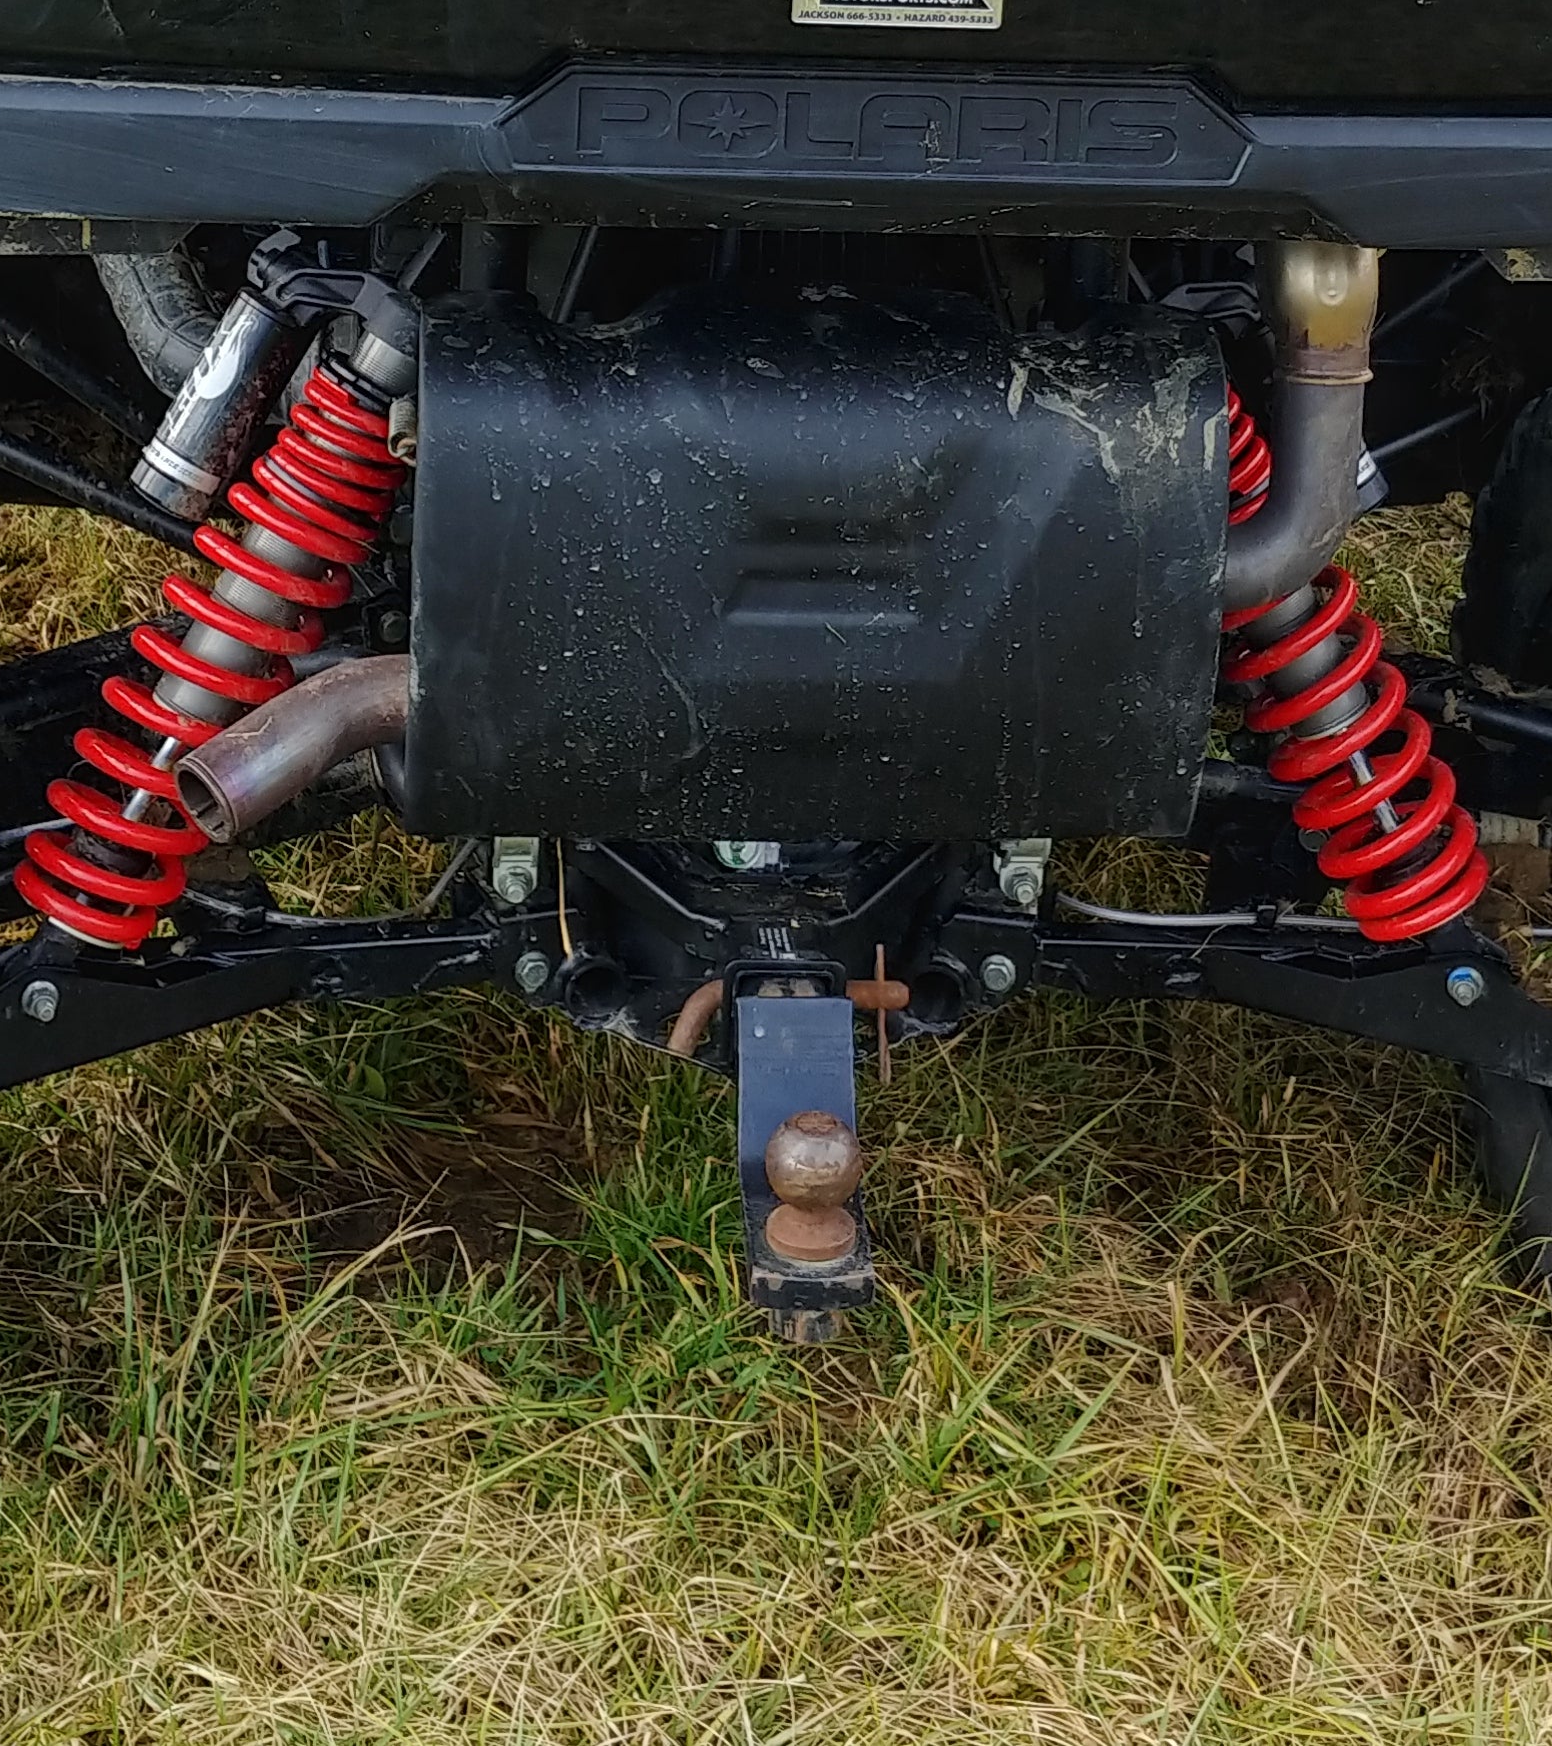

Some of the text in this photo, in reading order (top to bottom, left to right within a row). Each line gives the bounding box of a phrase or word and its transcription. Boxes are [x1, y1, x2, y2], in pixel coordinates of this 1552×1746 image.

[798, 10, 994, 24] JACKSON 666-5333 HAZARD 439-5333
[575, 86, 1180, 169] POLARIS
